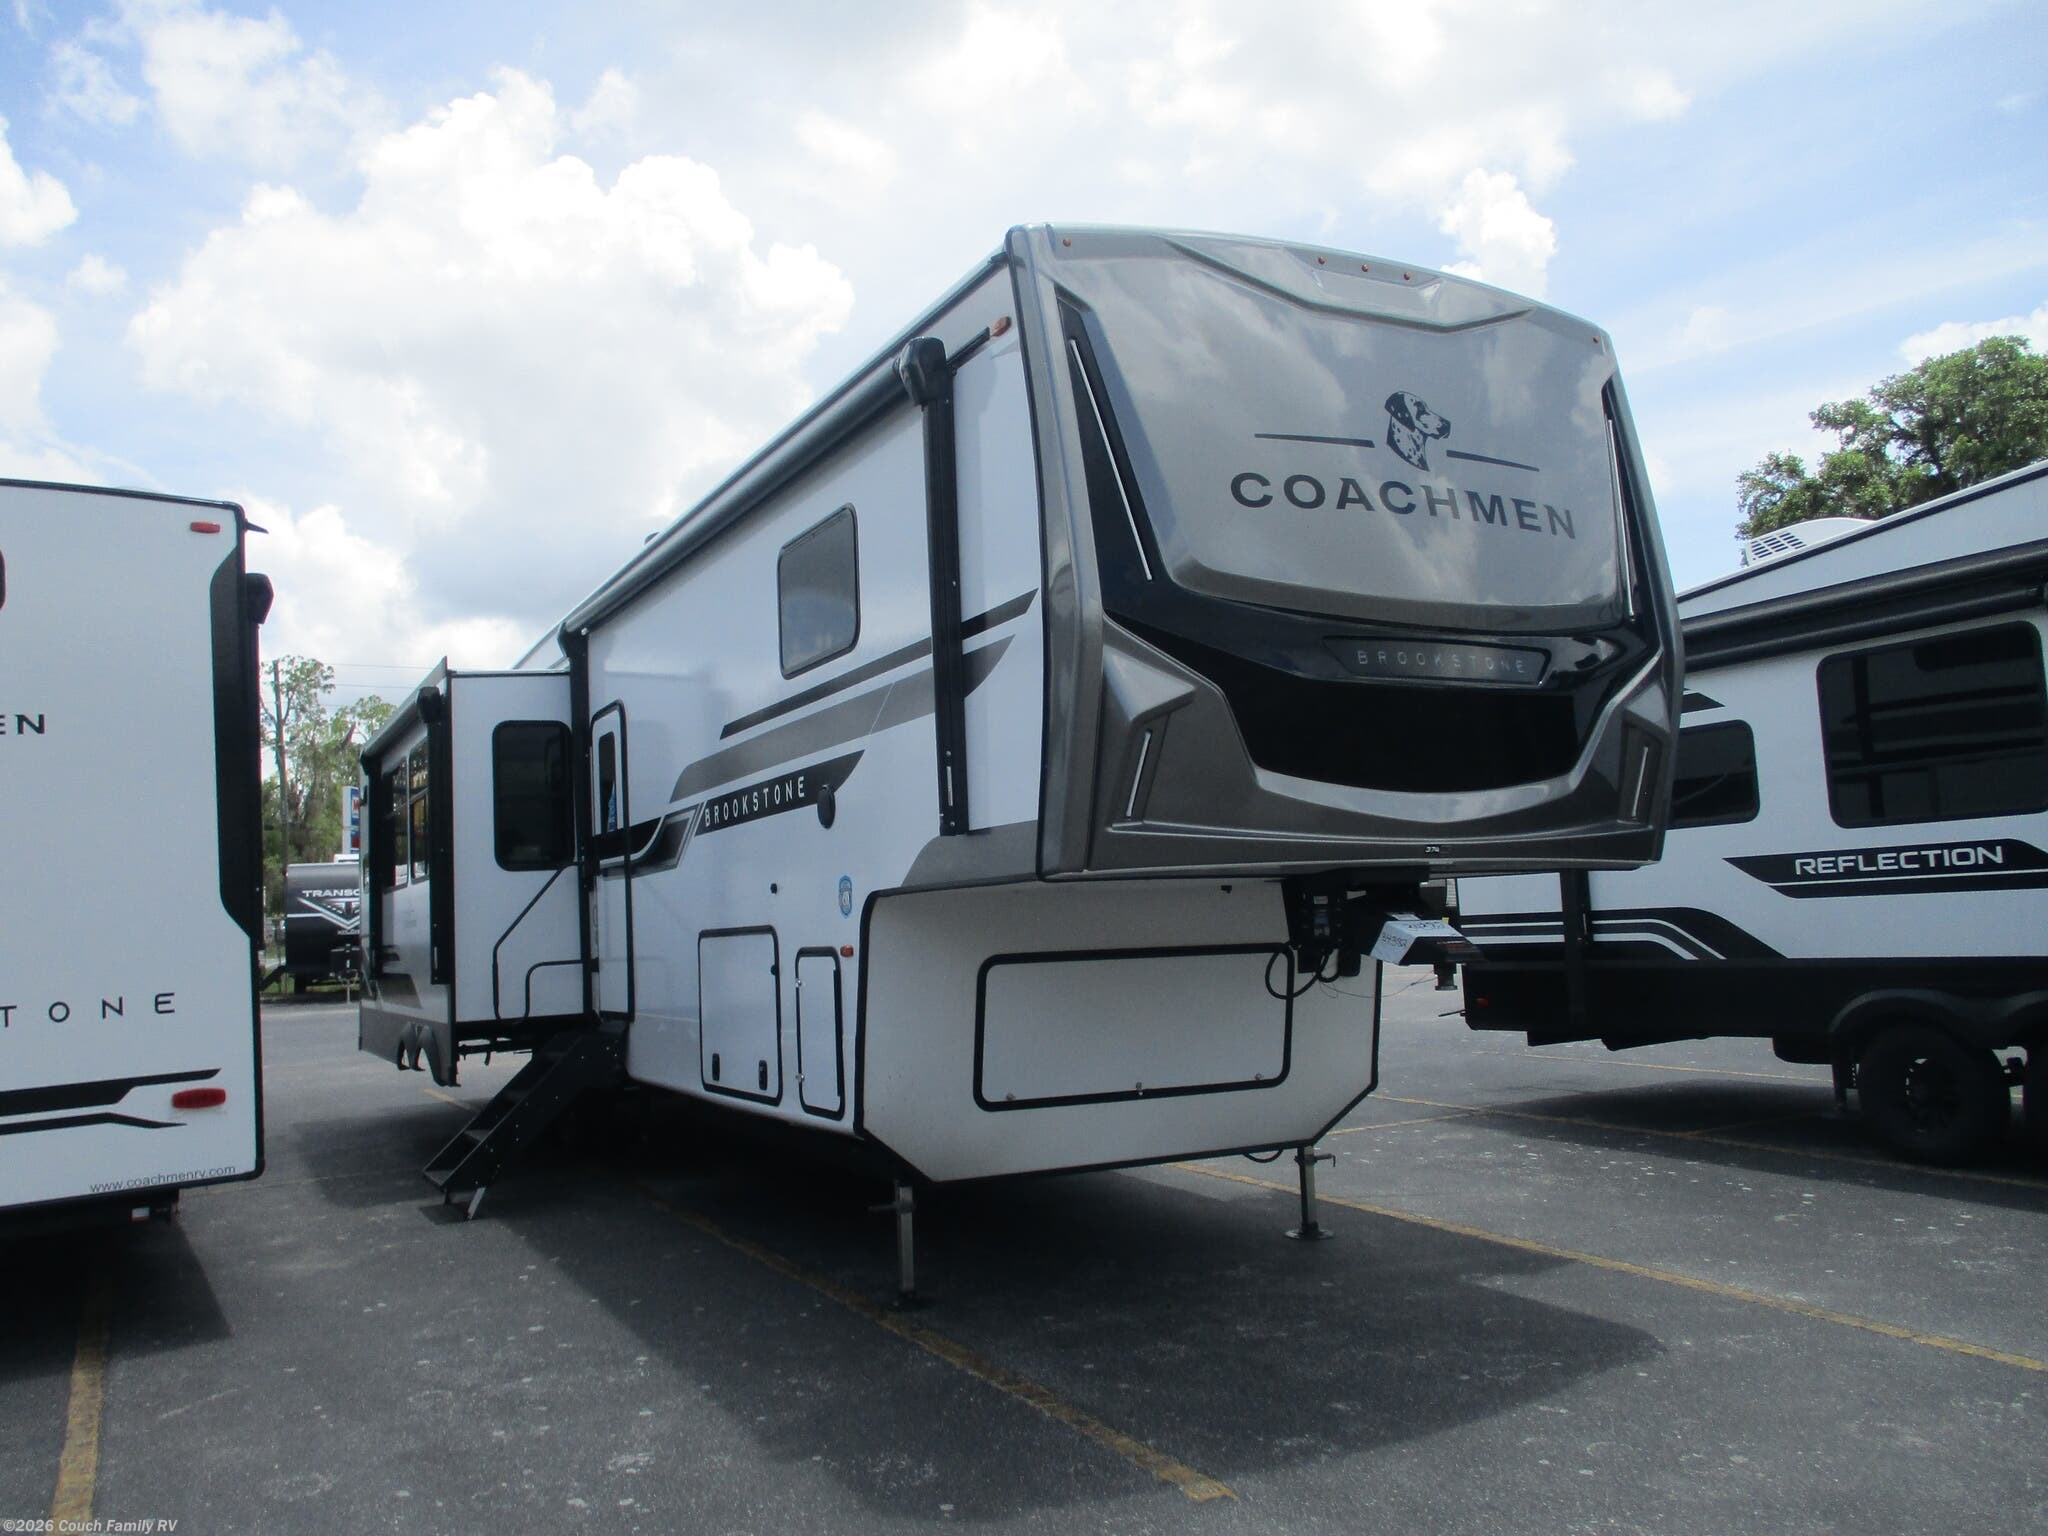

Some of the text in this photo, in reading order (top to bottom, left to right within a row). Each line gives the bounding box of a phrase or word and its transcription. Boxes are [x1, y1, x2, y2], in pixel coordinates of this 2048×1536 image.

[1230, 472, 1576, 540] COACHMEN
[1357, 651, 1526, 674] BROOKSTONE
[0, 714, 45, 735] N
[704, 776, 806, 827] BROOKSTONE
[1795, 845, 2004, 876] REFLECTION
[90, 1165, 236, 1193] www.coachmenrv.com
